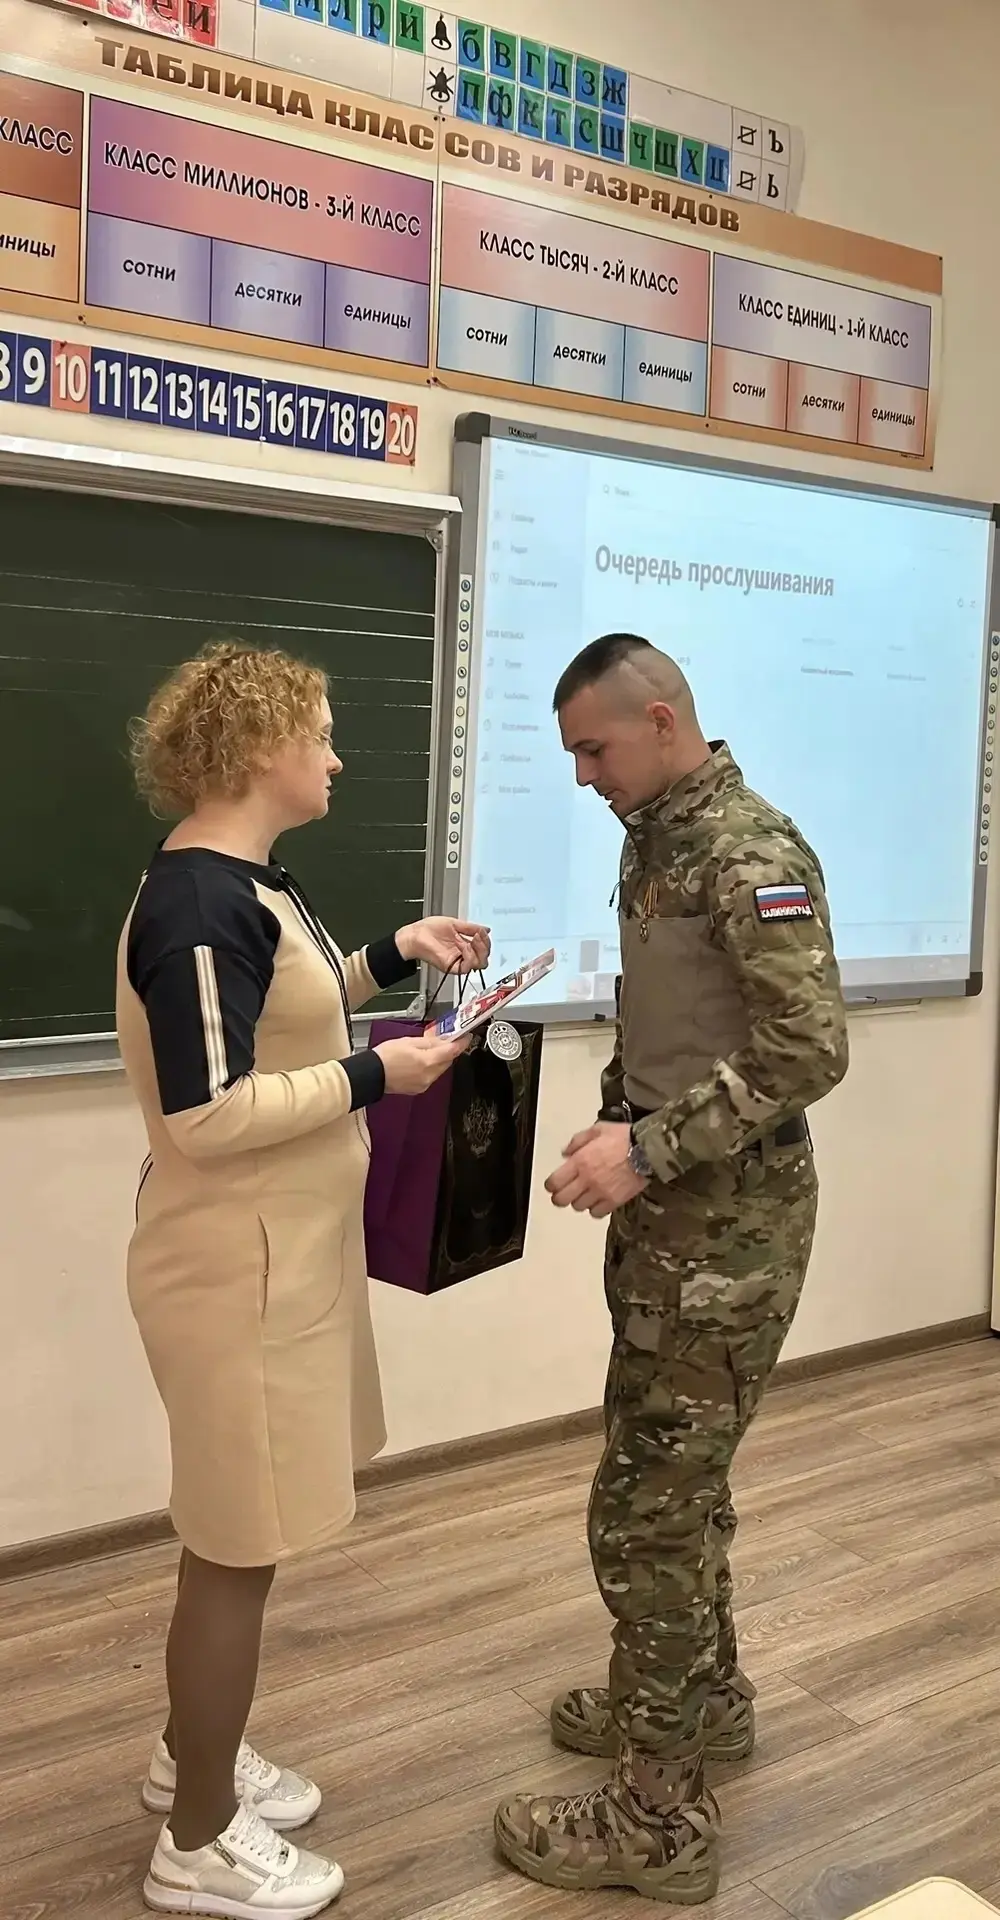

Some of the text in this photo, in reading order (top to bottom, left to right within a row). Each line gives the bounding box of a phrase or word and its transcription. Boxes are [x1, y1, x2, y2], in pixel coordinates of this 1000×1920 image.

[462, 28, 480, 63] б
[488, 86, 512, 126] ф
[95, 36, 314, 121] ТАБЛИЦА
[531, 155, 554, 182] И
[564, 164, 740, 232] РАЗРЯДОВ
[105, 142, 177, 179] КЛАСС
[184, 163, 309, 210] МИЛЛИОНОВ
[327, 195, 354, 221] 3-Й
[361, 205, 421, 237] КЛАСС
[123, 258, 176, 282] сотни
[480, 231, 534, 261] КЛАСС
[540, 244, 588, 274] ТЫСЯЧ
[603, 259, 626, 284] 2-Й
[630, 267, 679, 296] КЛАСС
[235, 282, 302, 307] десятки
[344, 304, 411, 330] единицы
[738, 294, 783, 321] КЛАСС
[787, 305, 837, 336] ЕДИНИЦ
[847, 314, 866, 339] 1-Й
[869, 324, 909, 349] КЛАСС
[466, 326, 508, 346] сотни
[553, 344, 606, 366] десятки
[638, 361, 692, 383] единицы
[23, 347, 46, 395] 9
[55, 354, 87, 402] 10
[94, 359, 122, 407] 11
[128, 363, 159, 414] 12
[165, 367, 193, 420] 13
[198, 377, 228, 426] 14
[232, 385, 262, 432] 15
[266, 390, 295, 437] 16
[298, 396, 325, 441] 17
[330, 402, 356, 446] 18
[360, 407, 386, 451] 19
[388, 412, 416, 457] 20
[733, 380, 766, 399] сотни
[801, 394, 845, 413] десятки
[872, 408, 916, 426] единицы
[595, 545, 834, 596] Очередь прослушивания
[761, 905, 813, 918] КАЛИНИНГРАД
